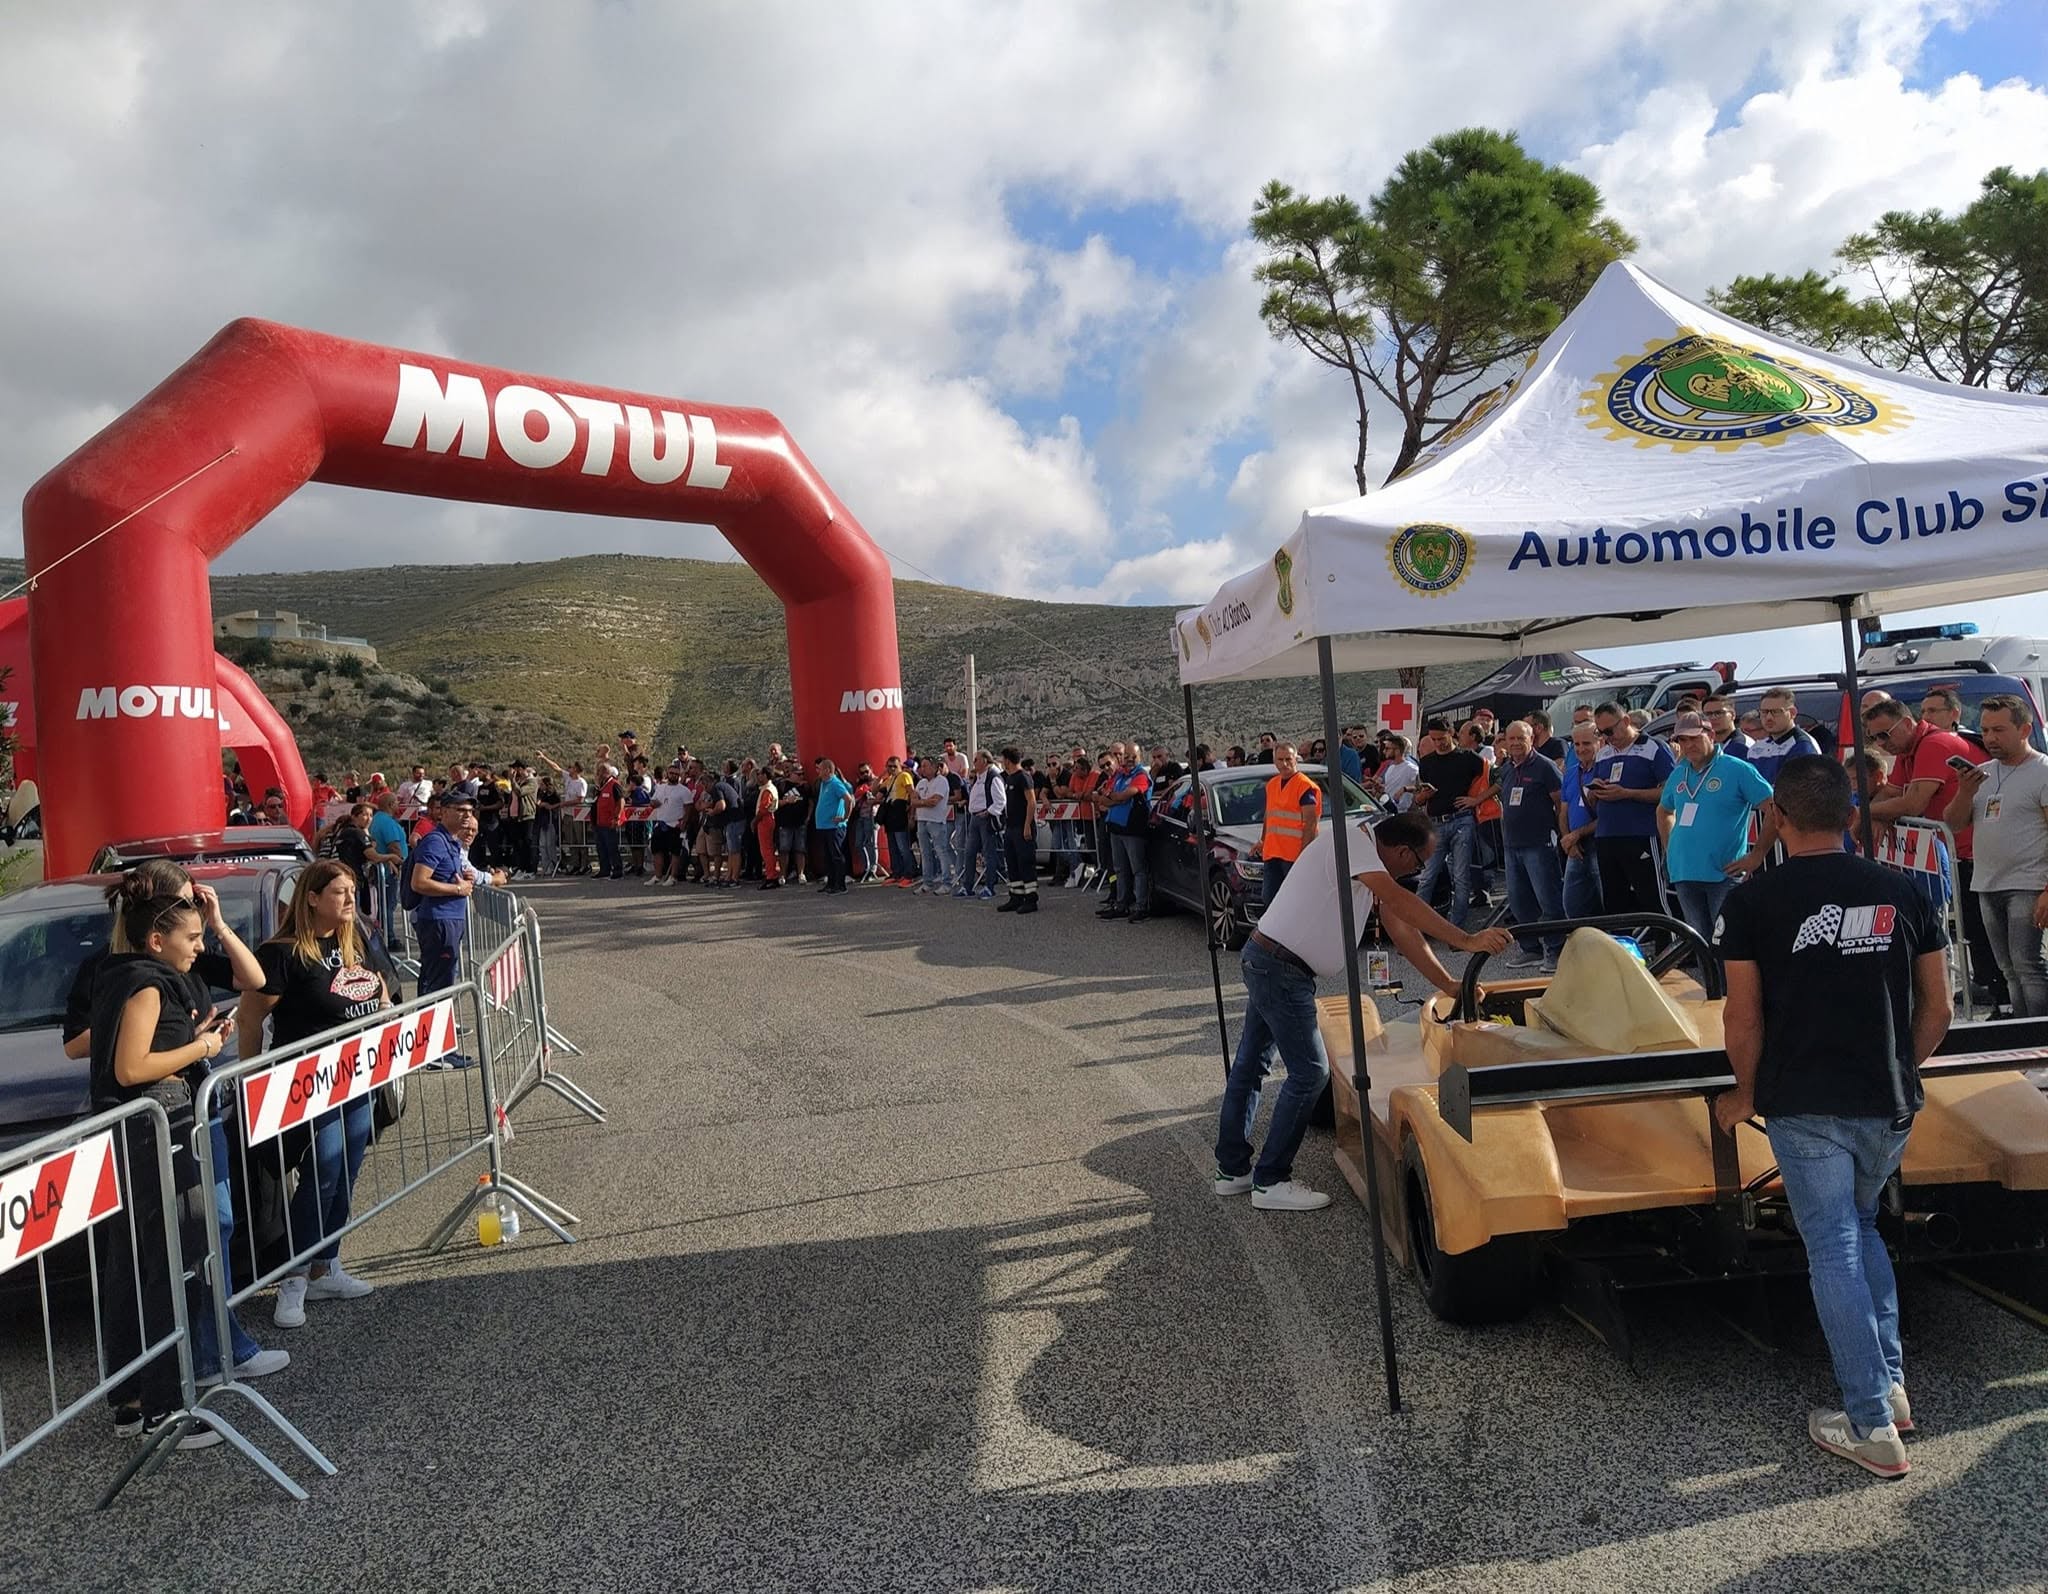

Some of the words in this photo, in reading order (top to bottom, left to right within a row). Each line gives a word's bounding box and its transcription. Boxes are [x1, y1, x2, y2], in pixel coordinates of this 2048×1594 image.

[382, 363, 733, 490] MOTUL
[1610, 378, 1767, 440] AUTOMOBILE
[1508, 507, 1836, 571] Automobile
[1856, 490, 1985, 546] Club
[75, 685, 215, 720] MOTUL
[840, 687, 903, 713] MOTU
[1837, 935, 1893, 949] MOTORS
[1840, 904, 1897, 940] MB
[289, 1053, 363, 1105] COMUNE
[367, 1042, 383, 1070] DI
[388, 1023, 430, 1059] AVOLA
